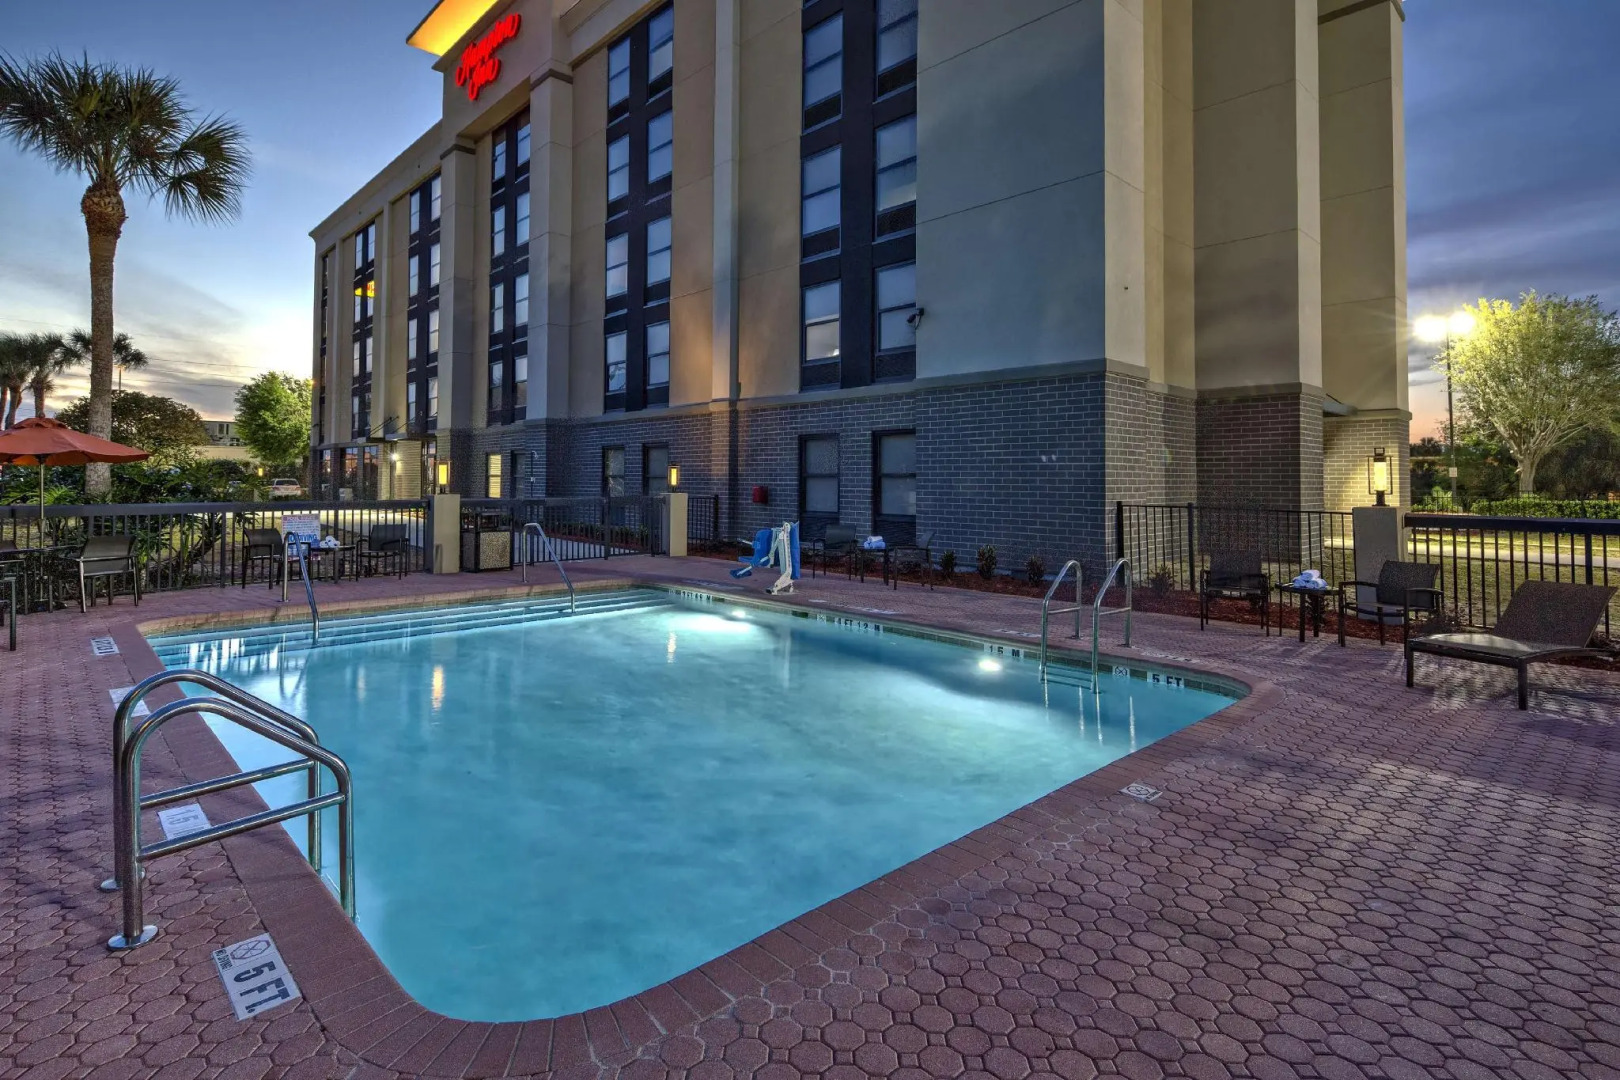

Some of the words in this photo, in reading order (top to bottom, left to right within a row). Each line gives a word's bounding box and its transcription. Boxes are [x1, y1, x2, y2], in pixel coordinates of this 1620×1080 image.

[1011, 648, 1020, 658] M
[1152, 673, 1160, 683] 5
[1166, 675, 1182, 687] FT
[233, 960, 277, 983] 5
